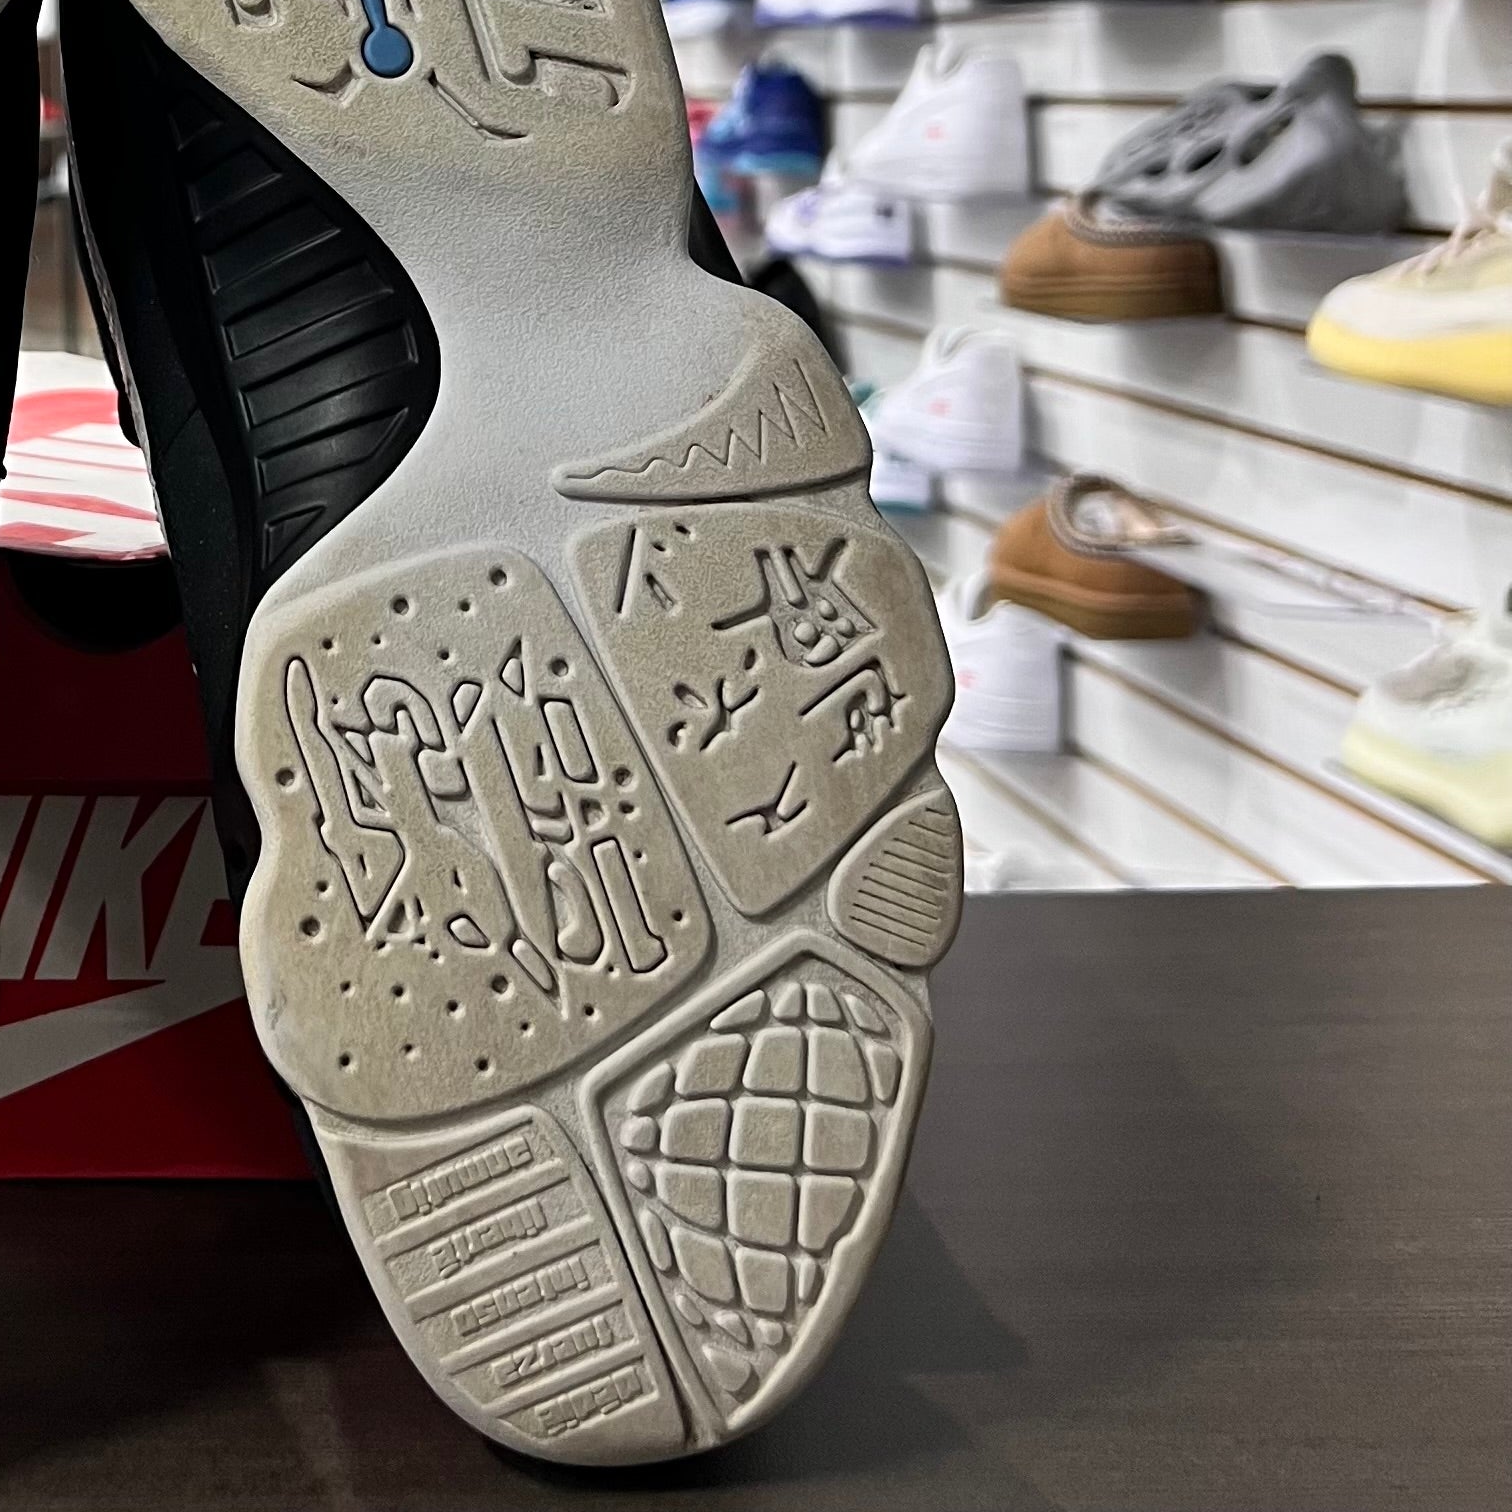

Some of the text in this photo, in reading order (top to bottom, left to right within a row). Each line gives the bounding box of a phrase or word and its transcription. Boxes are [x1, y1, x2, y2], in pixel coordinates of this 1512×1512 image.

[386, 1135, 533, 1222] anmutig
[428, 1197, 548, 1280] liberté
[450, 1256, 591, 1337] intenso
[490, 1314, 615, 1389] fuerza
